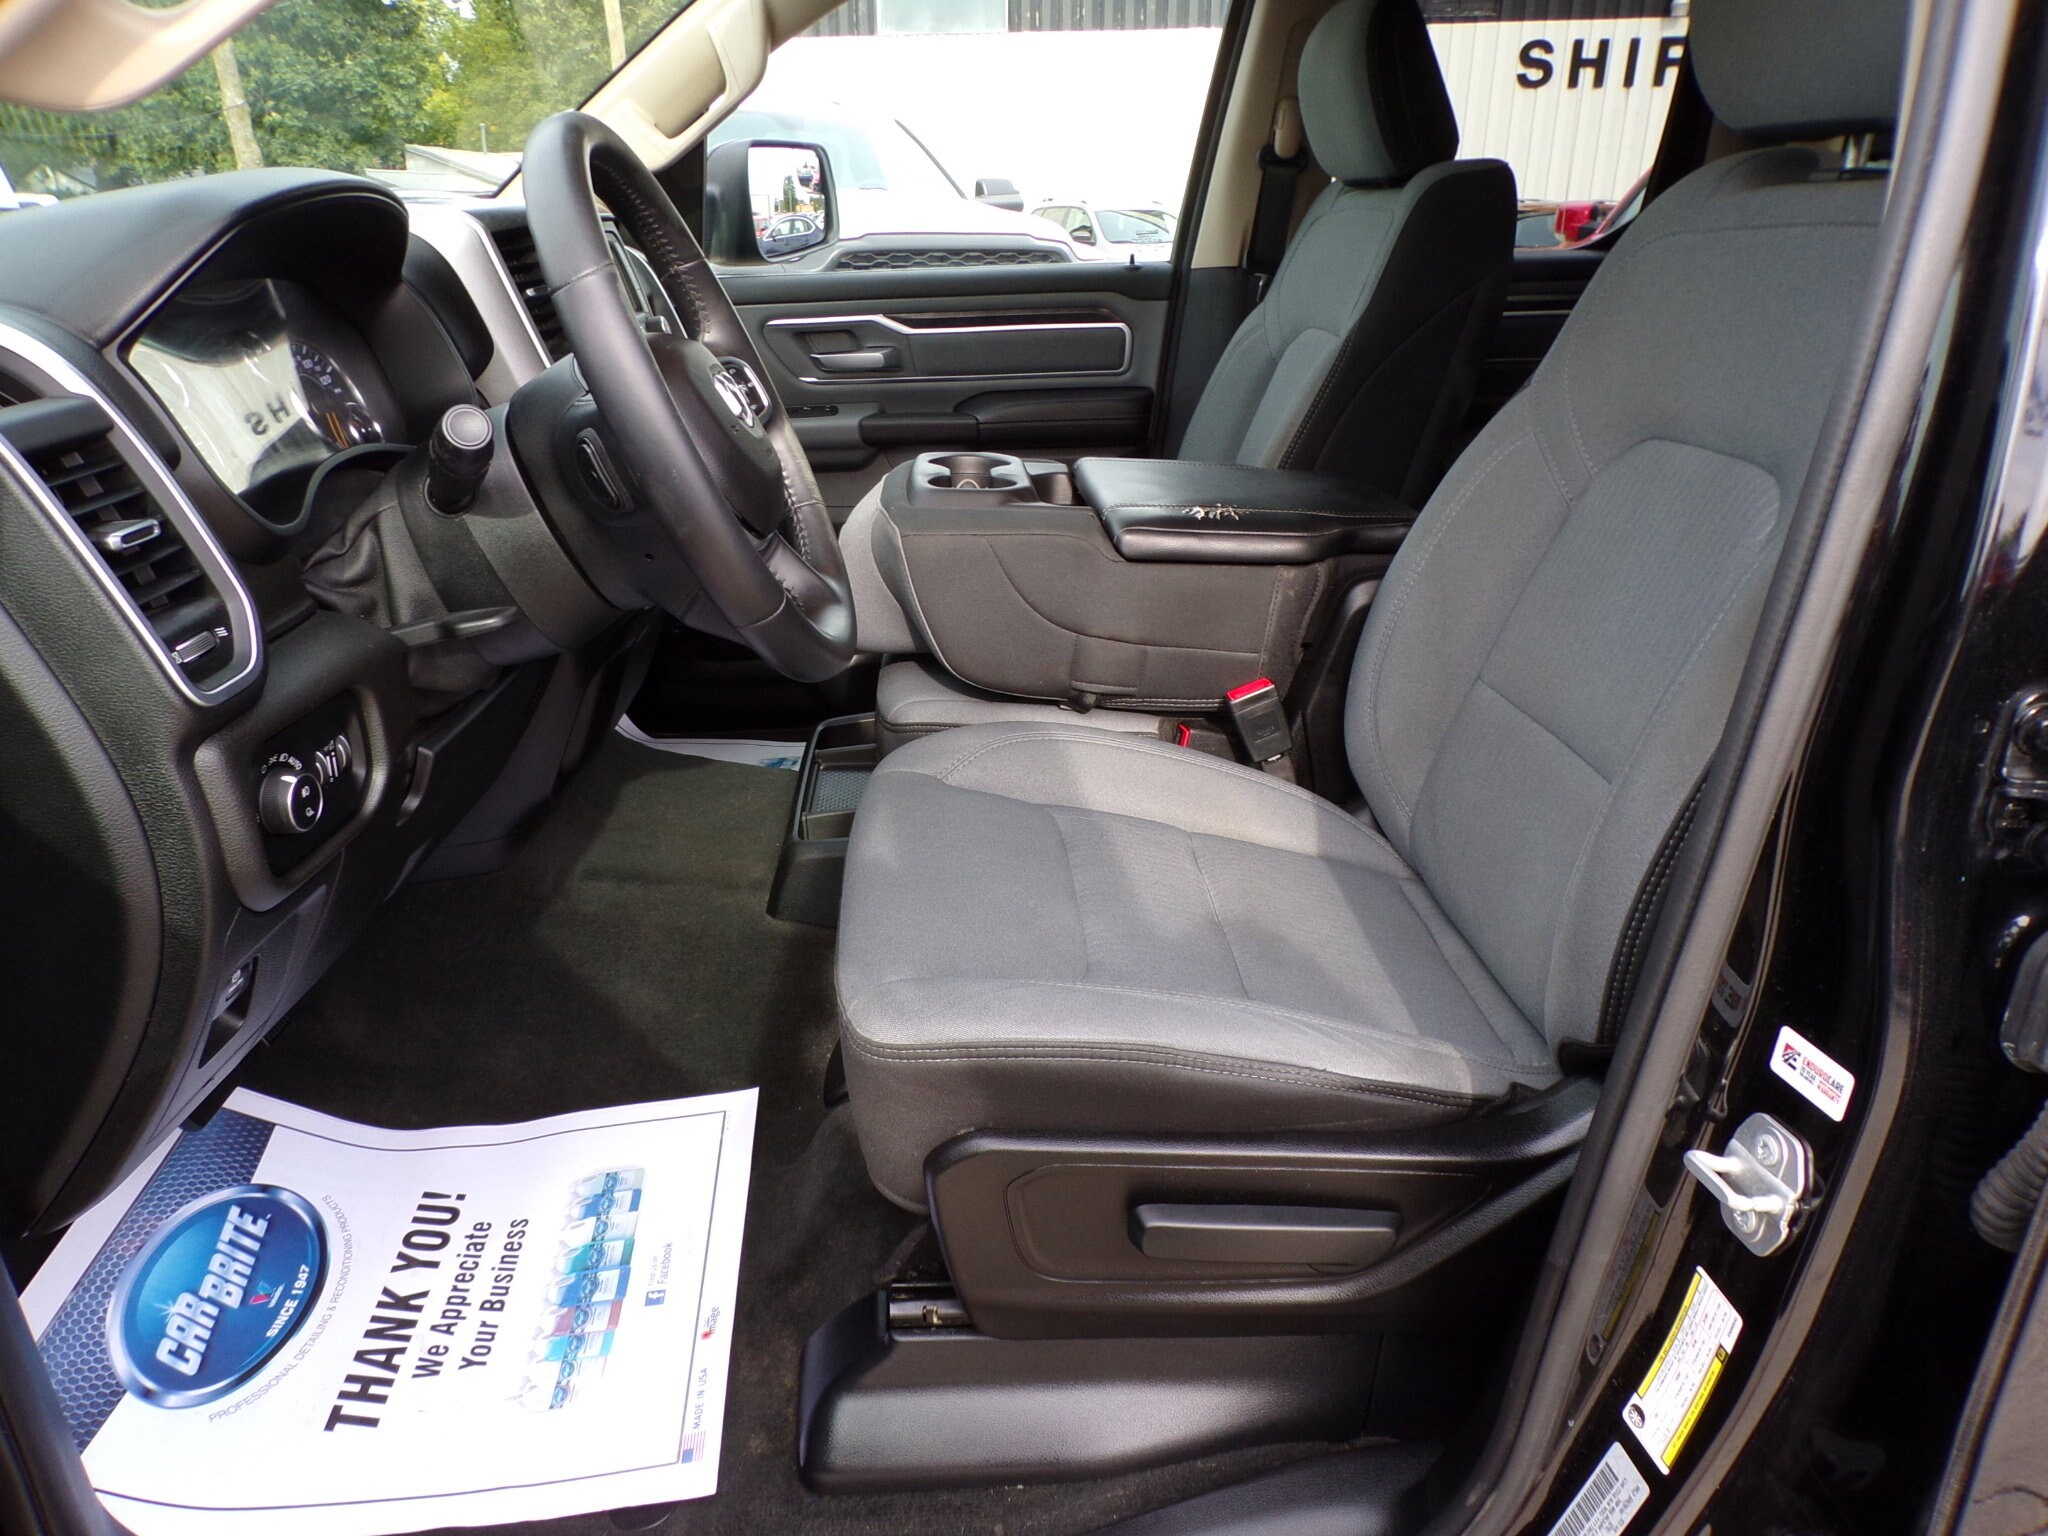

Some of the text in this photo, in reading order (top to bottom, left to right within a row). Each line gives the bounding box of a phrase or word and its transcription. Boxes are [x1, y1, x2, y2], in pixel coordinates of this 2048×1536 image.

[288, 756, 302, 770] AUTO
[321, 1194, 352, 1234] PRODUCTS
[156, 1205, 269, 1377] CAR BRITE
[328, 1232, 353, 1304] RECONDITIONING
[657, 1240, 673, 1284] Facebook
[265, 1295, 299, 1339] SINCE
[293, 1264, 311, 1296] 1947
[323, 1190, 467, 1432] THANK YOU!
[412, 1219, 492, 1379] We Appreciate
[458, 1217, 529, 1371] Your Business
[296, 1313, 333, 1365] DETAILING
[208, 1362, 299, 1424] PROFESSIONAL
[698, 1366, 708, 1386] USA
[692, 1400, 705, 1429] MADE
